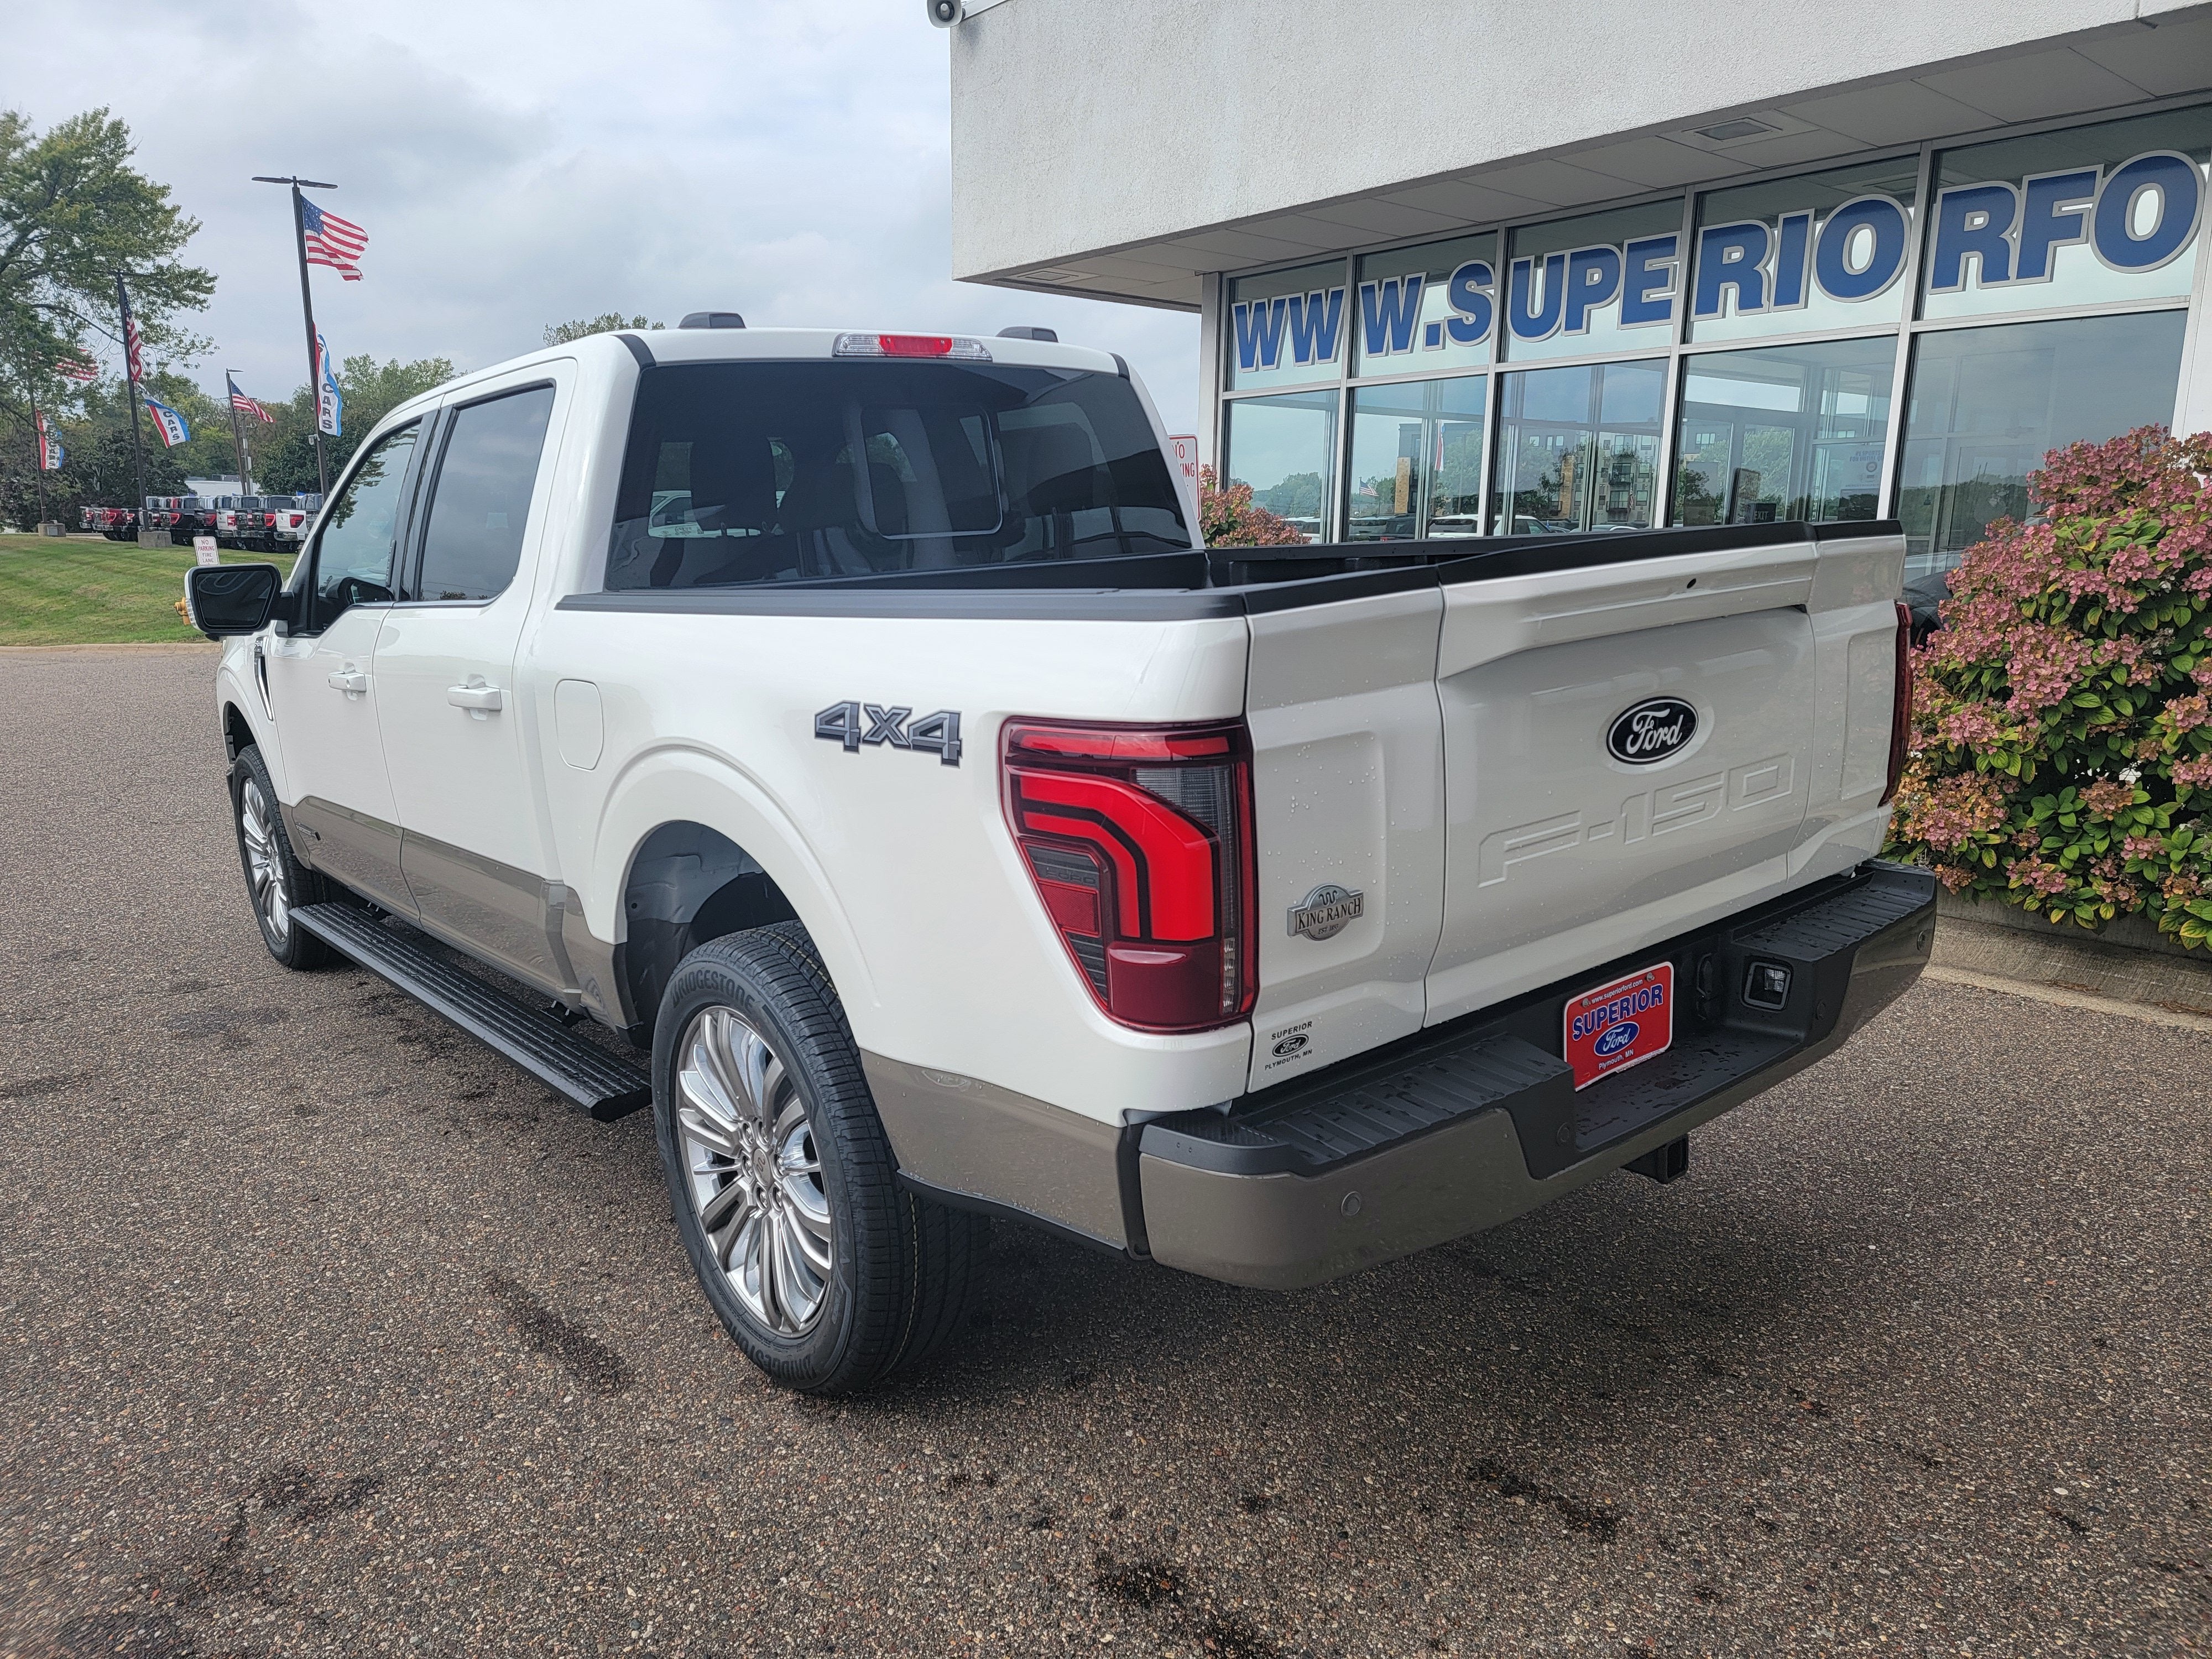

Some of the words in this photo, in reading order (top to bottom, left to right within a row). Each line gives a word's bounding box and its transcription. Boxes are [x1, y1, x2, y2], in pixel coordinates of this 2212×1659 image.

[322, 383, 334, 429] CARS
[163, 411, 180, 440] CARS
[1478, 753, 1795, 888] F-150
[1298, 911, 1324, 930] KING
[1327, 898, 1361, 922] RANCH
[1591, 979, 1643, 1005] www.superiorford.com
[1572, 983, 1663, 1041] SUPERIOR
[1271, 1021, 1312, 1040] SUPERIOR
[1265, 1054, 1301, 1070] PLYMOUTH,
[1599, 1053, 1625, 1070] Plymouth,
[1625, 1048, 1634, 1057] MN
